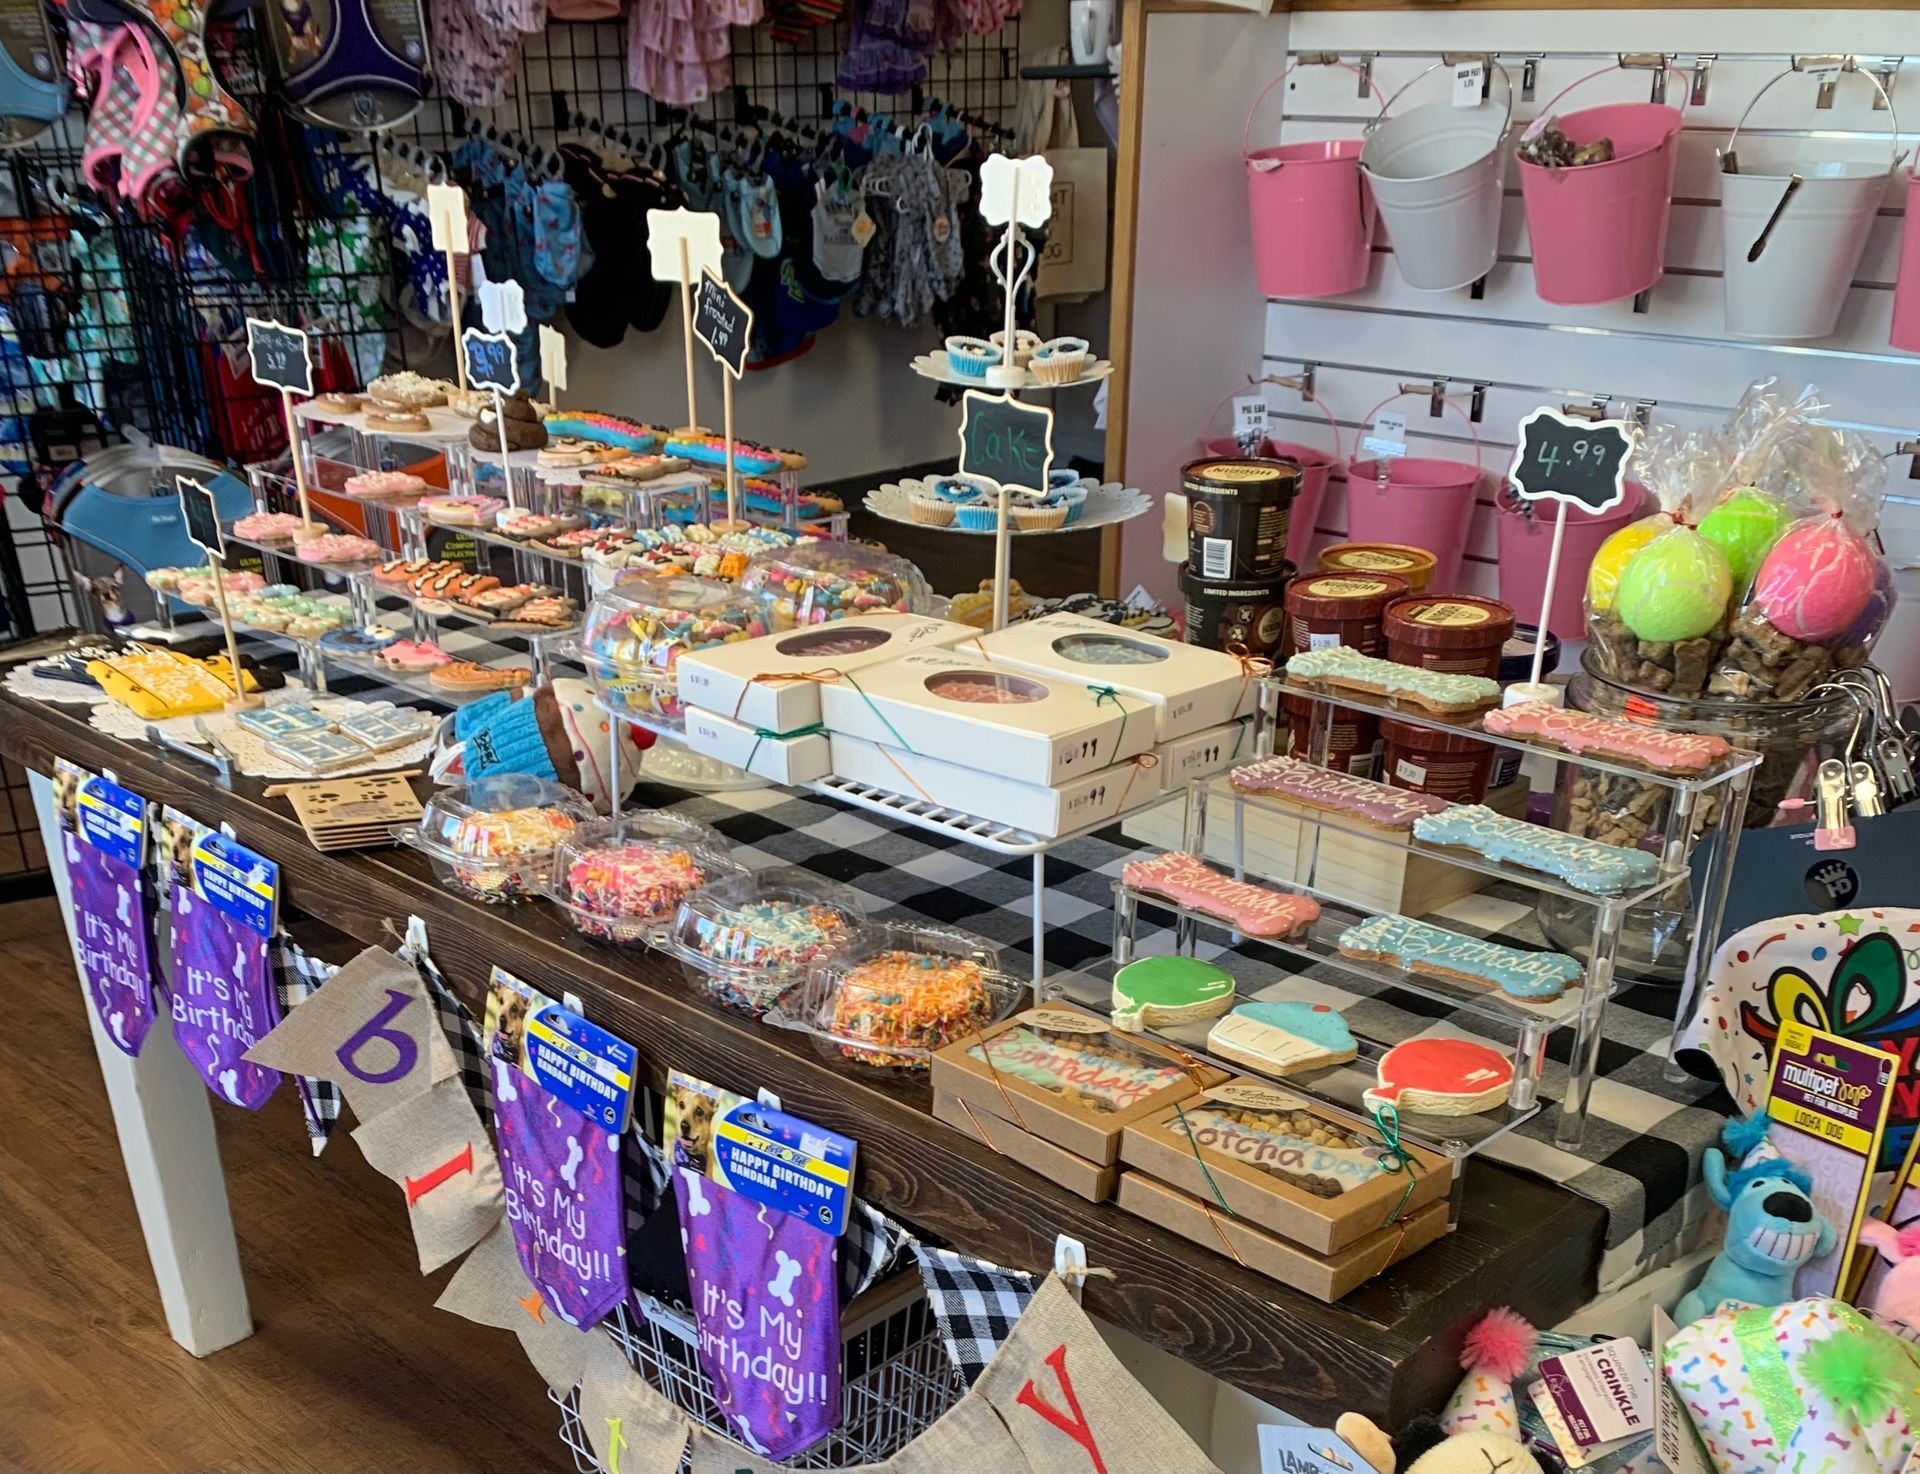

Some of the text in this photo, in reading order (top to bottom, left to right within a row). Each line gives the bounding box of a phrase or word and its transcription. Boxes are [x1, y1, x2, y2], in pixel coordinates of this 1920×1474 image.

[704, 297, 736, 333] frosted
[1537, 440, 1607, 478] 4.99
[1199, 485, 1239, 496] INGREDIENTS
[1203, 587, 1270, 597] LIMITED INGREDIENTS
[228, 881, 266, 911] BIRTHDAY
[84, 910, 115, 946] It's
[1398, 923, 1566, 988] Birthday
[187, 965, 231, 1001] It's
[536, 1056, 574, 1089] BANDANA
[538, 1043, 620, 1103] HAPPY BIRTHDAY
[1782, 1063, 1840, 1098] multipet
[1826, 1120, 1845, 1141] DOG
[729, 1160, 778, 1191] BANDANA
[730, 1146, 834, 1200] HAPPY BIRTHDAY
[512, 1161, 586, 1240] It's My
[703, 1279, 803, 1361] It's My
[698, 1322, 827, 1406] irthday!!
[1606, 1345, 1639, 1400] squeeze me
[1596, 1358, 1641, 1427] CRINKLE
